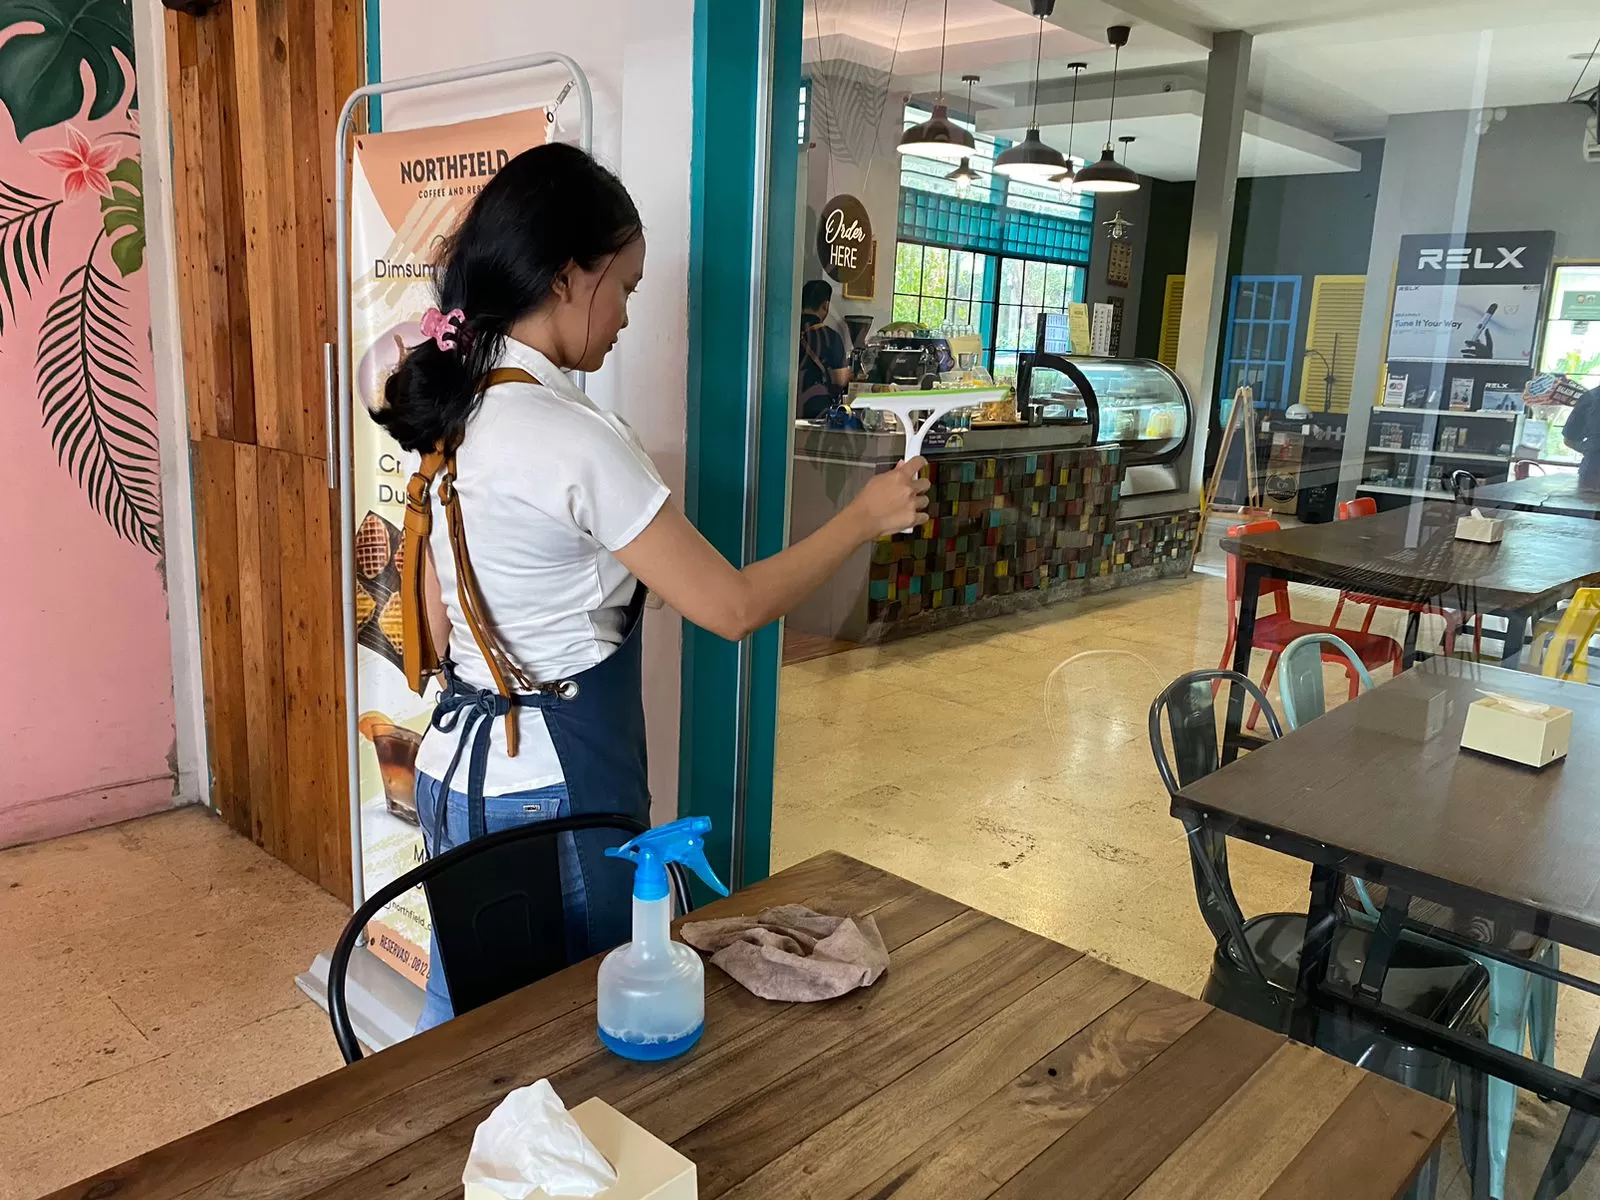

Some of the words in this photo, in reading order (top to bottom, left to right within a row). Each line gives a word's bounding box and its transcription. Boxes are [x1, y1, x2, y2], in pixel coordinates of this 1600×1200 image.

[400, 149, 509, 184] NORTHFIELD
[418, 188, 445, 199] COFFEE
[448, 187, 464, 197] AND
[825, 208, 866, 244] Order
[830, 244, 857, 269] HERE
[1417, 246, 1528, 270] RELX
[1423, 319, 1442, 328] Your
[1443, 319, 1463, 330] Way
